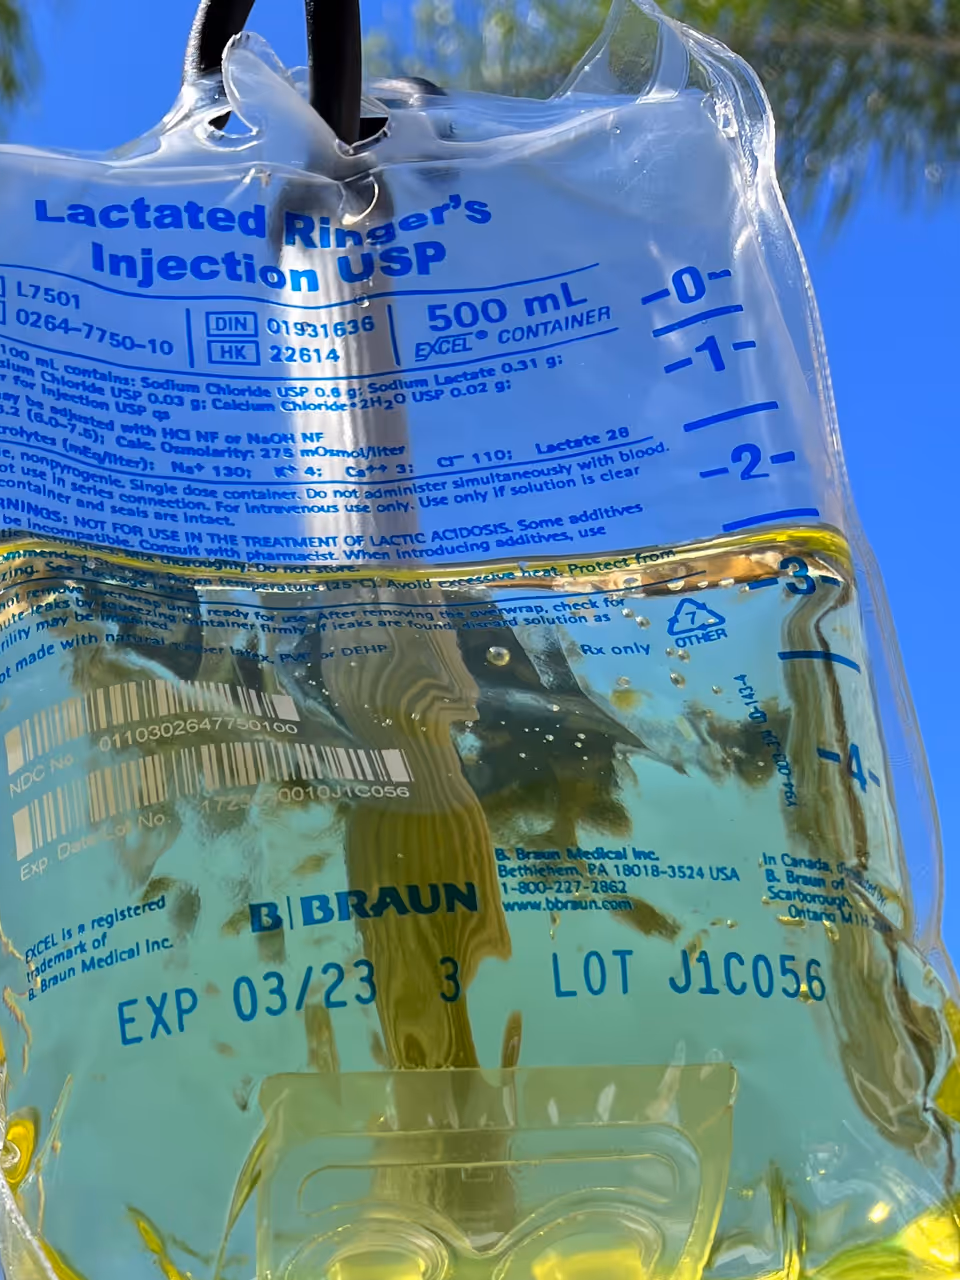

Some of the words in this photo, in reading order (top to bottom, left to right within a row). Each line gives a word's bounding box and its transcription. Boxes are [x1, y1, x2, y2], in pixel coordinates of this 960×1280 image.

[35, 197, 266, 238] Lactated
[91, 241, 319, 292] Injection
[337, 241, 446, 283] USP
[16, 280, 80, 310] L7501
[427, 298, 508, 332] 500
[523, 281, 588, 318] mL
[16, 308, 174, 357] 0264-7750-10
[215, 316, 248, 332] DIN
[267, 315, 376, 339] 01931636
[498, 306, 611, 345] CONTAINER
[0, 343, 30, 362] 100
[36, 357, 59, 371] mL
[205, 382, 272, 398] Chloride
[277, 386, 309, 398] USP
[367, 373, 428, 394] Sodium
[434, 366, 496, 386] Lactate
[500, 358, 538, 374] 0.31
[220, 344, 247, 361] HK
[268, 345, 341, 364] 22614
[13, 375, 36, 391] for
[114, 401, 147, 416] USP
[41, 370, 105, 396] Chloride
[110, 386, 143, 401] USP
[147, 391, 185, 407] 0.03
[412, 388, 444, 403] USP
[450, 383, 489, 399] 0.02
[302, 432, 325, 444] NF
[535, 434, 601, 455] Lactate
[129, 478, 178, 496] Single
[182, 484, 218, 498] dose
[306, 488, 327, 499] Do
[333, 488, 360, 499] not
[364, 481, 447, 499] administer
[452, 465, 573, 489] simultaneously
[577, 454, 615, 472] with
[619, 441, 670, 463] blood.
[21, 466, 47, 481] use
[52, 472, 66, 488] in
[70, 480, 114, 500] series
[215, 501, 241, 513] For
[344, 503, 372, 513] use
[376, 499, 415, 514] only.
[419, 494, 449, 509] Use
[453, 489, 488, 506] only
[492, 485, 506, 498] if
[510, 477, 577, 496] solution
[581, 471, 596, 486] is
[599, 464, 640, 483] clear
[74, 515, 107, 532] NOT
[111, 522, 144, 537] FOR
[148, 527, 180, 541] USE
[184, 531, 202, 543] IN
[206, 532, 239, 545] THE
[241, 535, 339, 548] TREATMENT
[343, 535, 369, 547] OF
[370, 531, 427, 547] LACTIC
[430, 521, 514, 543] ACIDOSIS.
[517, 514, 563, 532] Some
[568, 502, 644, 525] additives
[76, 498, 105, 512] and
[110, 504, 149, 519] seals
[153, 511, 179, 522] are
[2, 513, 22, 526] be
[139, 538, 200, 556] Consult
[204, 545, 240, 559] with
[342, 549, 391, 561] When
[397, 540, 491, 561] introducing
[495, 529, 574, 548] additives,
[578, 525, 607, 538] use
[387, 579, 432, 590] Avoid
[519, 565, 562, 578] heat.
[568, 558, 630, 574] Protect
[635, 549, 676, 565] from
[31, 598, 71, 616] leaks
[378, 619, 403, 628] are
[524, 614, 588, 627] solution
[594, 612, 611, 622] as
[36, 615, 68, 632] may
[75, 611, 94, 621] be
[207, 608, 249, 620] ready
[255, 611, 276, 622] for
[317, 609, 356, 621] After
[363, 608, 434, 621] removing
[552, 599, 598, 612] check
[603, 597, 625, 608] for
[685, 610, 697, 625] 7
[15, 642, 55, 673] made
[60, 632, 98, 649] with
[580, 643, 604, 655] Rx
[611, 642, 651, 656] only
[674, 627, 728, 648] OTHER
[99, 717, 298, 754] 0110302647750100
[9, 767, 45, 798] NDC
[495, 848, 510, 861] B.
[516, 848, 561, 860] Braun
[567, 847, 627, 860] Medical
[633, 848, 660, 861] Inc.
[762, 852, 777, 866] In
[498, 864, 583, 878] Bethlehem,
[587, 864, 608, 876] PA
[614, 864, 704, 880] 18018-3524
[709, 867, 740, 882] USA
[502, 880, 627, 894] 1-800-227-2862
[765, 868, 781, 883] B.
[786, 870, 826, 888] Braun
[25, 933, 58, 964] EXCEL
[62, 927, 73, 941] is
[91, 895, 166, 929] registered
[26, 940, 87, 983] trademark
[92, 932, 107, 950] of
[29, 988, 37, 1001] B.
[41, 966, 76, 994] Braun
[81, 942, 140, 973] Medical
[145, 937, 174, 954] Inc.
[117, 987, 199, 1046] EXP
[233, 957, 378, 1022] 03/23
[552, 950, 634, 998] LOT
[669, 949, 826, 1002] J1C056
